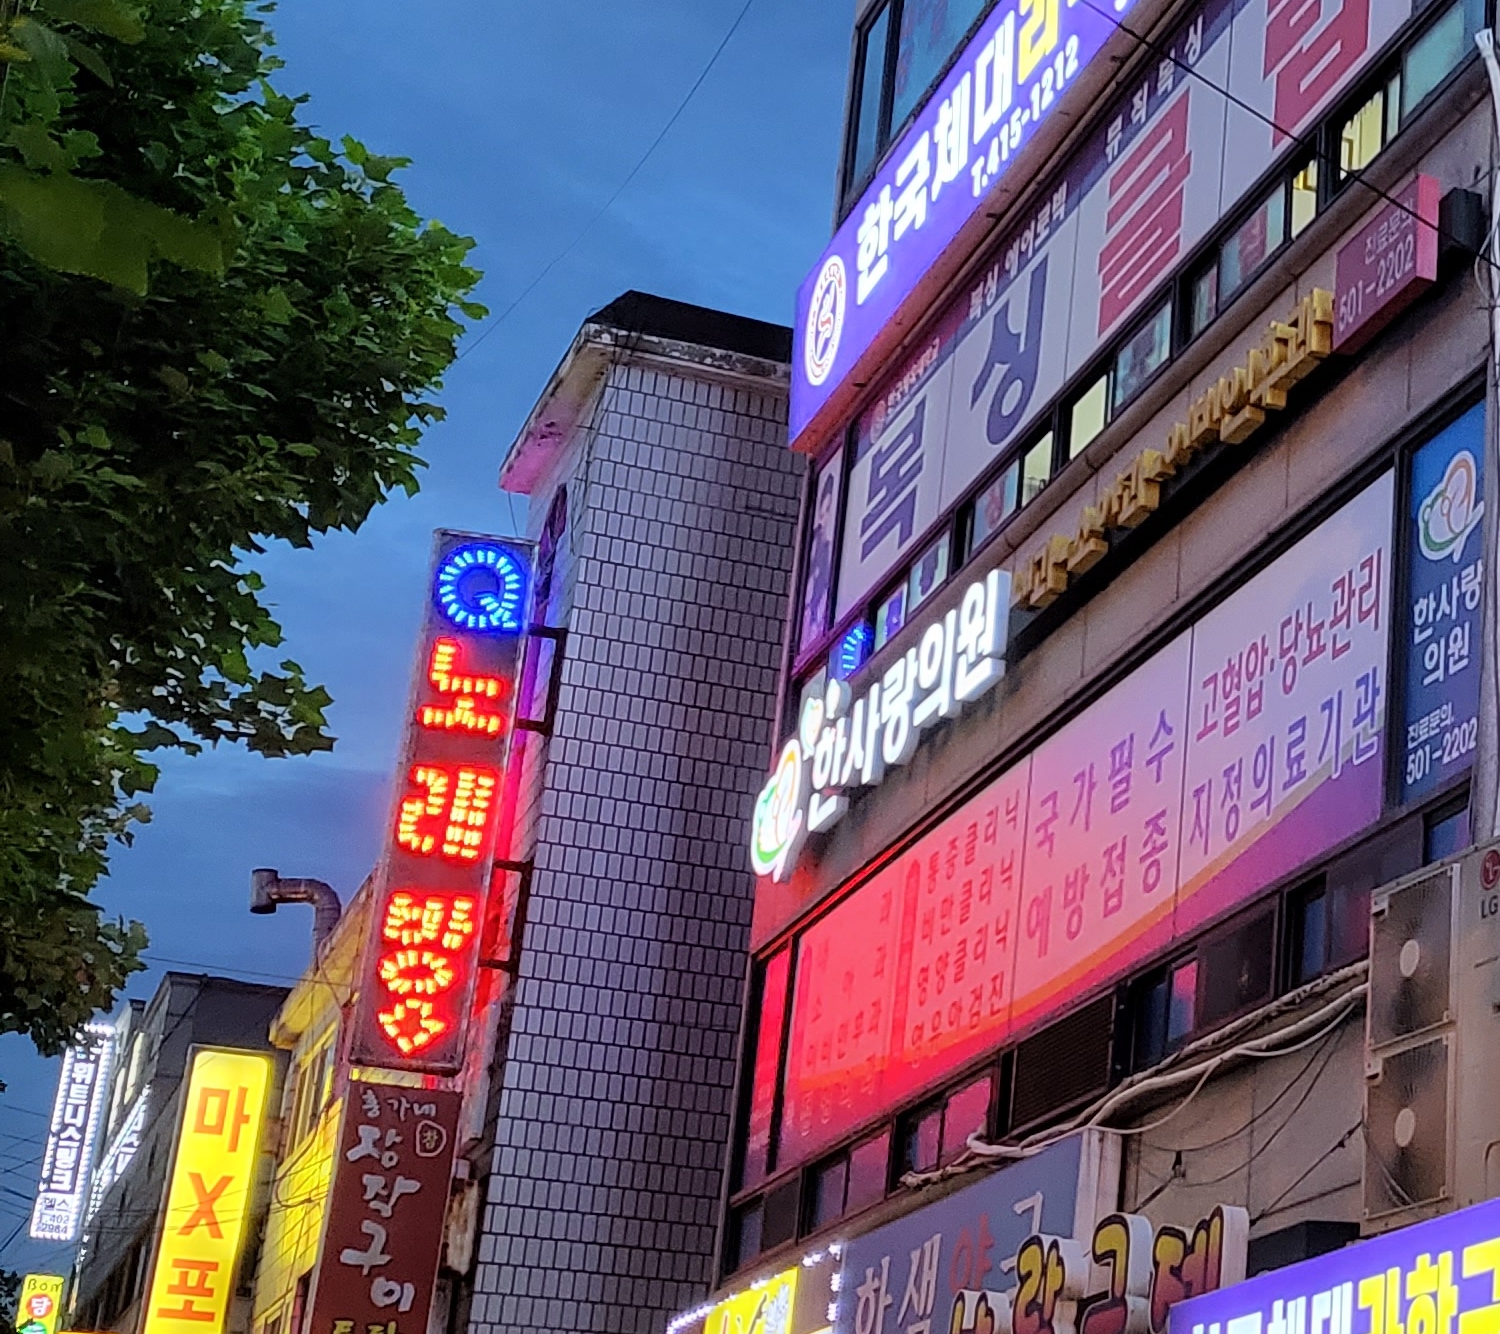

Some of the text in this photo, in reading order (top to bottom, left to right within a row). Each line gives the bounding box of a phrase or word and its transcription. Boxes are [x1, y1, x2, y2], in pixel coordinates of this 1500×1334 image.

[1364, 198, 1414, 266] 진료문의
[1338, 233, 1415, 333] 501-2202
[1413, 559, 1483, 644] 한사랑
[1423, 620, 1470, 686] 의원
[806, 570, 1006, 834] 한사랑의원
[1406, 714, 1479, 785] 501-2202
[378, 635, 509, 996] 노래방
[1480, 893, 1499, 921] LG
